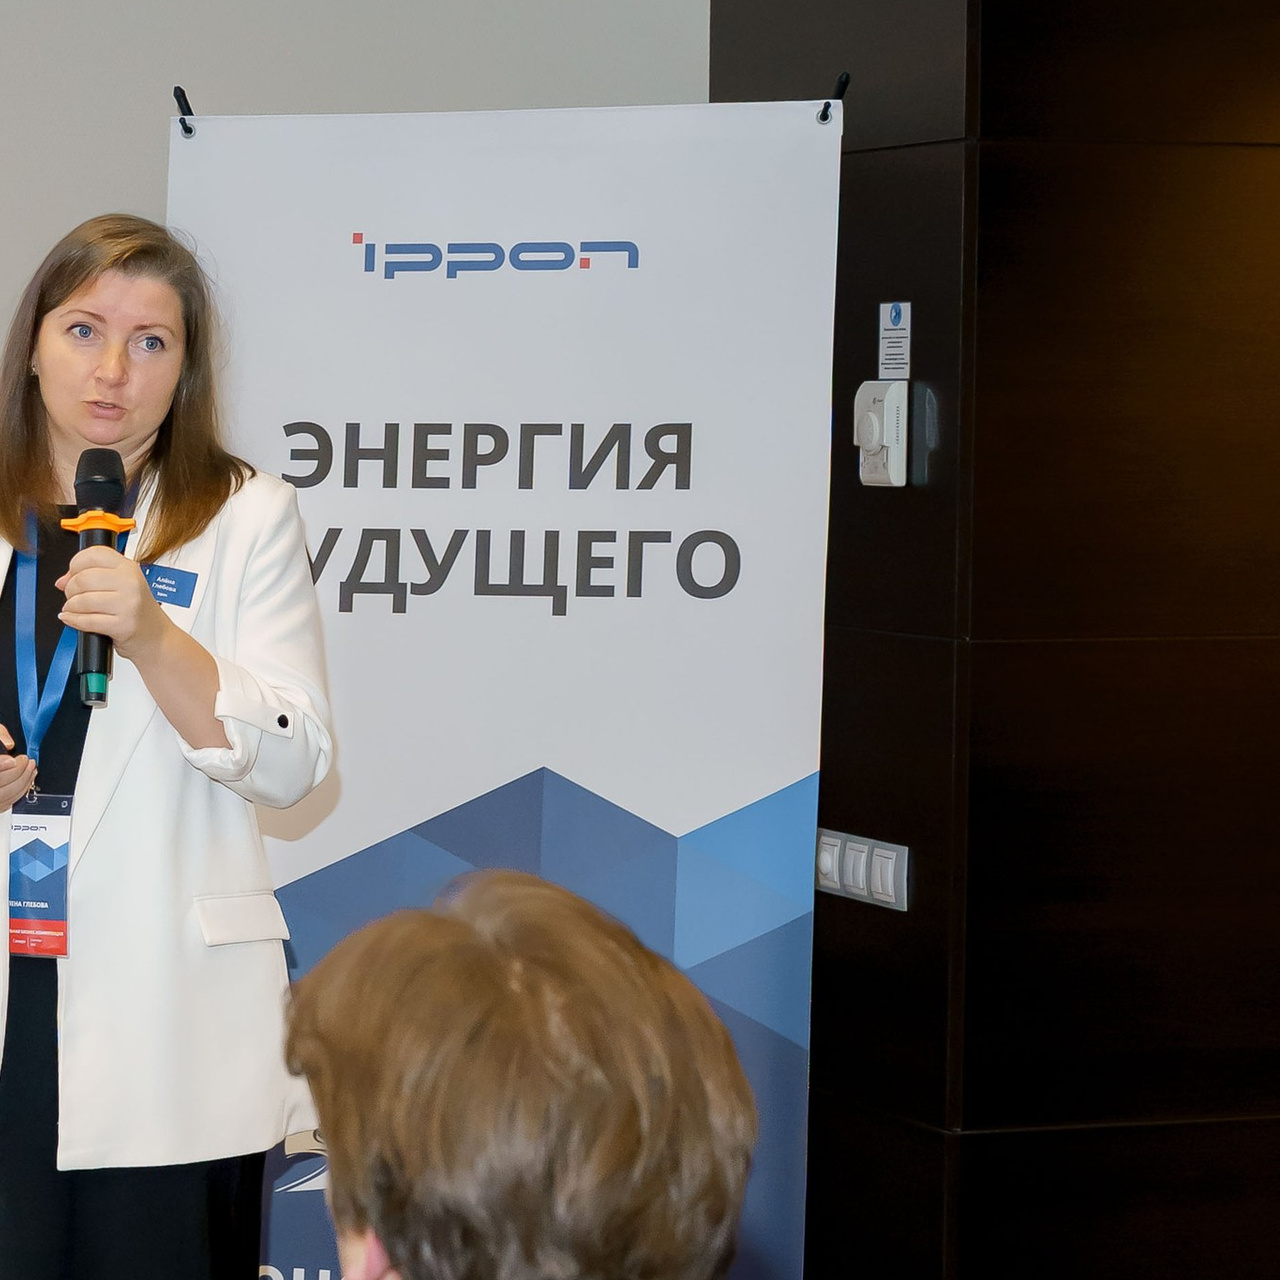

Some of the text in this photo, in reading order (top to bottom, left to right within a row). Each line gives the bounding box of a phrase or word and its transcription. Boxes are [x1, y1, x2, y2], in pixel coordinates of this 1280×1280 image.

[352, 232, 640, 280] ippon
[281, 421, 693, 491] ЭНЕРГИЯ
[304, 527, 742, 617] УДУЩЕГО
